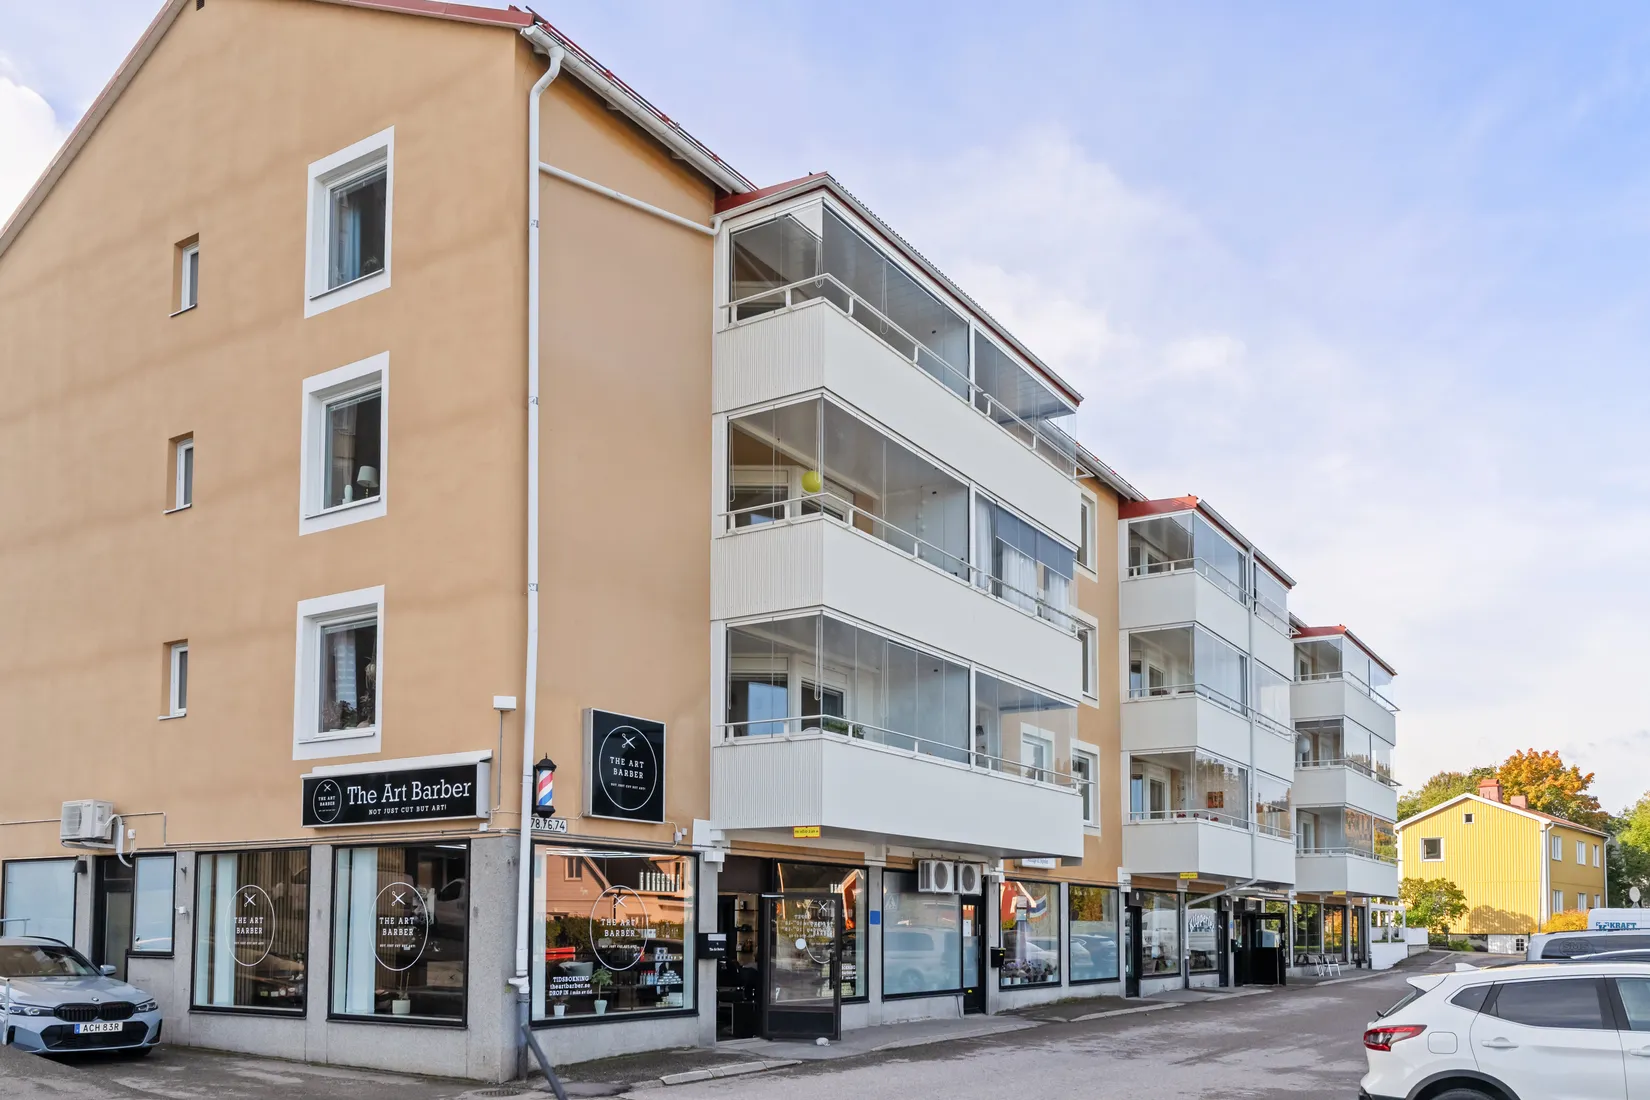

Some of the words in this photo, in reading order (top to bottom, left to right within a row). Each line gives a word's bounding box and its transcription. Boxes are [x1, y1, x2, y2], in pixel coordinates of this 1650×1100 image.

[609, 756, 626, 766] THE
[628, 759, 645, 769] ART
[613, 767, 644, 779] BARBER
[347, 786, 377, 805] The
[381, 783, 407, 803] Art
[411, 779, 472, 800] Barber
[383, 807, 399, 815] JUST
[233, 916, 247, 924] THE
[249, 916, 264, 924] ART
[379, 916, 395, 925] THE
[398, 916, 415, 925] ART
[600, 918, 617, 926] THE
[1609, 921, 1637, 929] KRAFT
[236, 927, 263, 935] BARBER
[382, 928, 414, 936] BARBER
[604, 929, 635, 937] BARBER
[552, 975, 590, 983] TIDSBOKNING
[83, 1023, 101, 1032] ACH
[102, 1022, 119, 1032] 83R
